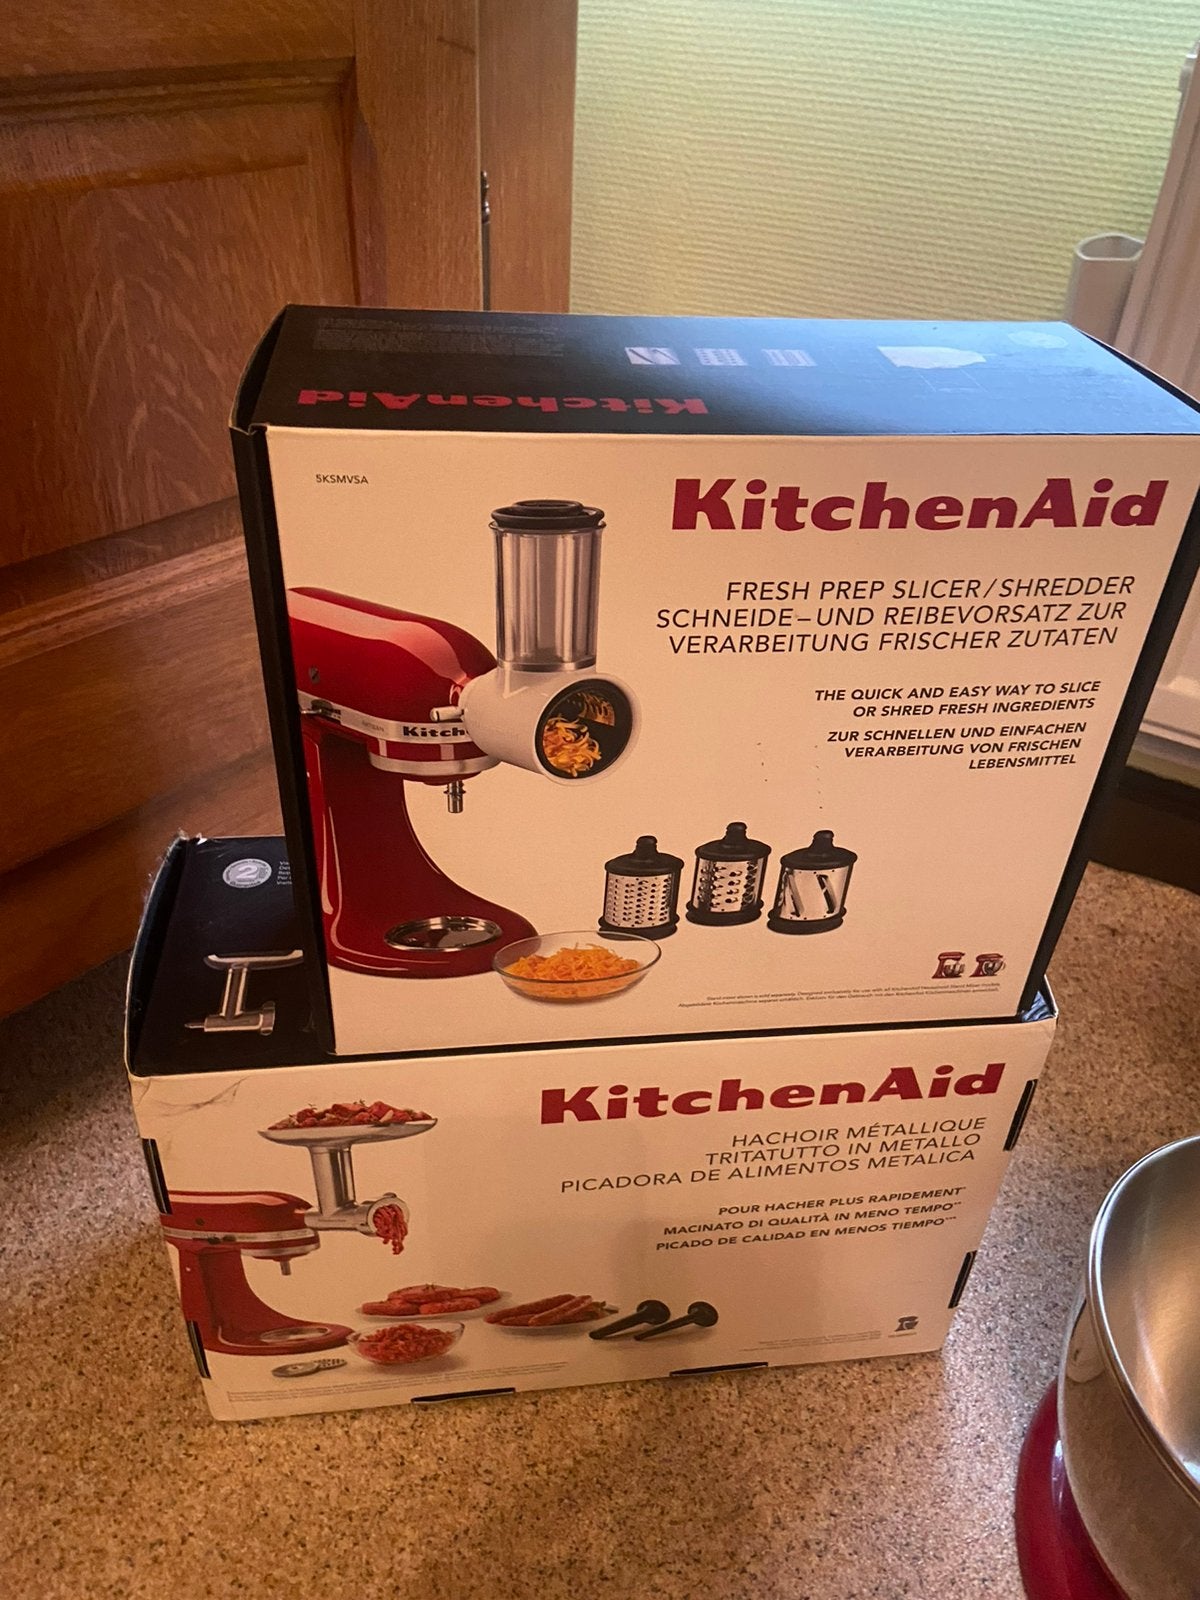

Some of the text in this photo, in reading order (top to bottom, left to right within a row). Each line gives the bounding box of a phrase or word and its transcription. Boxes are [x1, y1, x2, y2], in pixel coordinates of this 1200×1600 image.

[299, 390, 709, 415] KitchenAid
[315, 473, 369, 485] 5KSMVSA
[672, 478, 1169, 531] KitchenAid
[726, 581, 810, 602] FRESH
[819, 580, 886, 601] PREP
[883, 603, 1072, 626] REIBEVORSATZ
[1076, 601, 1128, 622] ZUR
[668, 626, 1119, 655] VERARBEITUNG FRISCHER ZUTATEN
[815, 680, 1102, 702] THE QUICK AND EASY WAY TO SLICE
[852, 697, 1097, 718] OR SHRED FRESH INGREDIENTS
[826, 721, 1088, 743] ZUR SCHNELLEN UND EINFACHEN
[844, 737, 1082, 758] VERARBEITUNG VON FRISCHEN
[968, 753, 1077, 770] LEBENSMITTEL
[540, 1063, 1006, 1125] KitchenAid
[731, 1116, 987, 1148] HACHOIR MÉTALLIQUE
[704, 1132, 981, 1166] TRITATUTTO IN METALLO
[561, 1149, 975, 1194] PICADORA DE ALIMENTOS METALICA
[718, 1204, 761, 1216] POUR
[764, 1199, 826, 1213] HACHER
[829, 1195, 865, 1207] PLUS
[663, 1220, 744, 1236] MACINATO
[747, 1219, 764, 1229] DI
[767, 1210, 830, 1227] QUALITÀ
[833, 1212, 851, 1222] IN
[854, 1207, 900, 1220] MENO
[656, 1238, 714, 1251] PICADO
[717, 1236, 738, 1246] DE
[741, 1230, 806, 1244] CALIDAD
[809, 1228, 831, 1239] EN
[834, 1223, 888, 1236] MENOS
